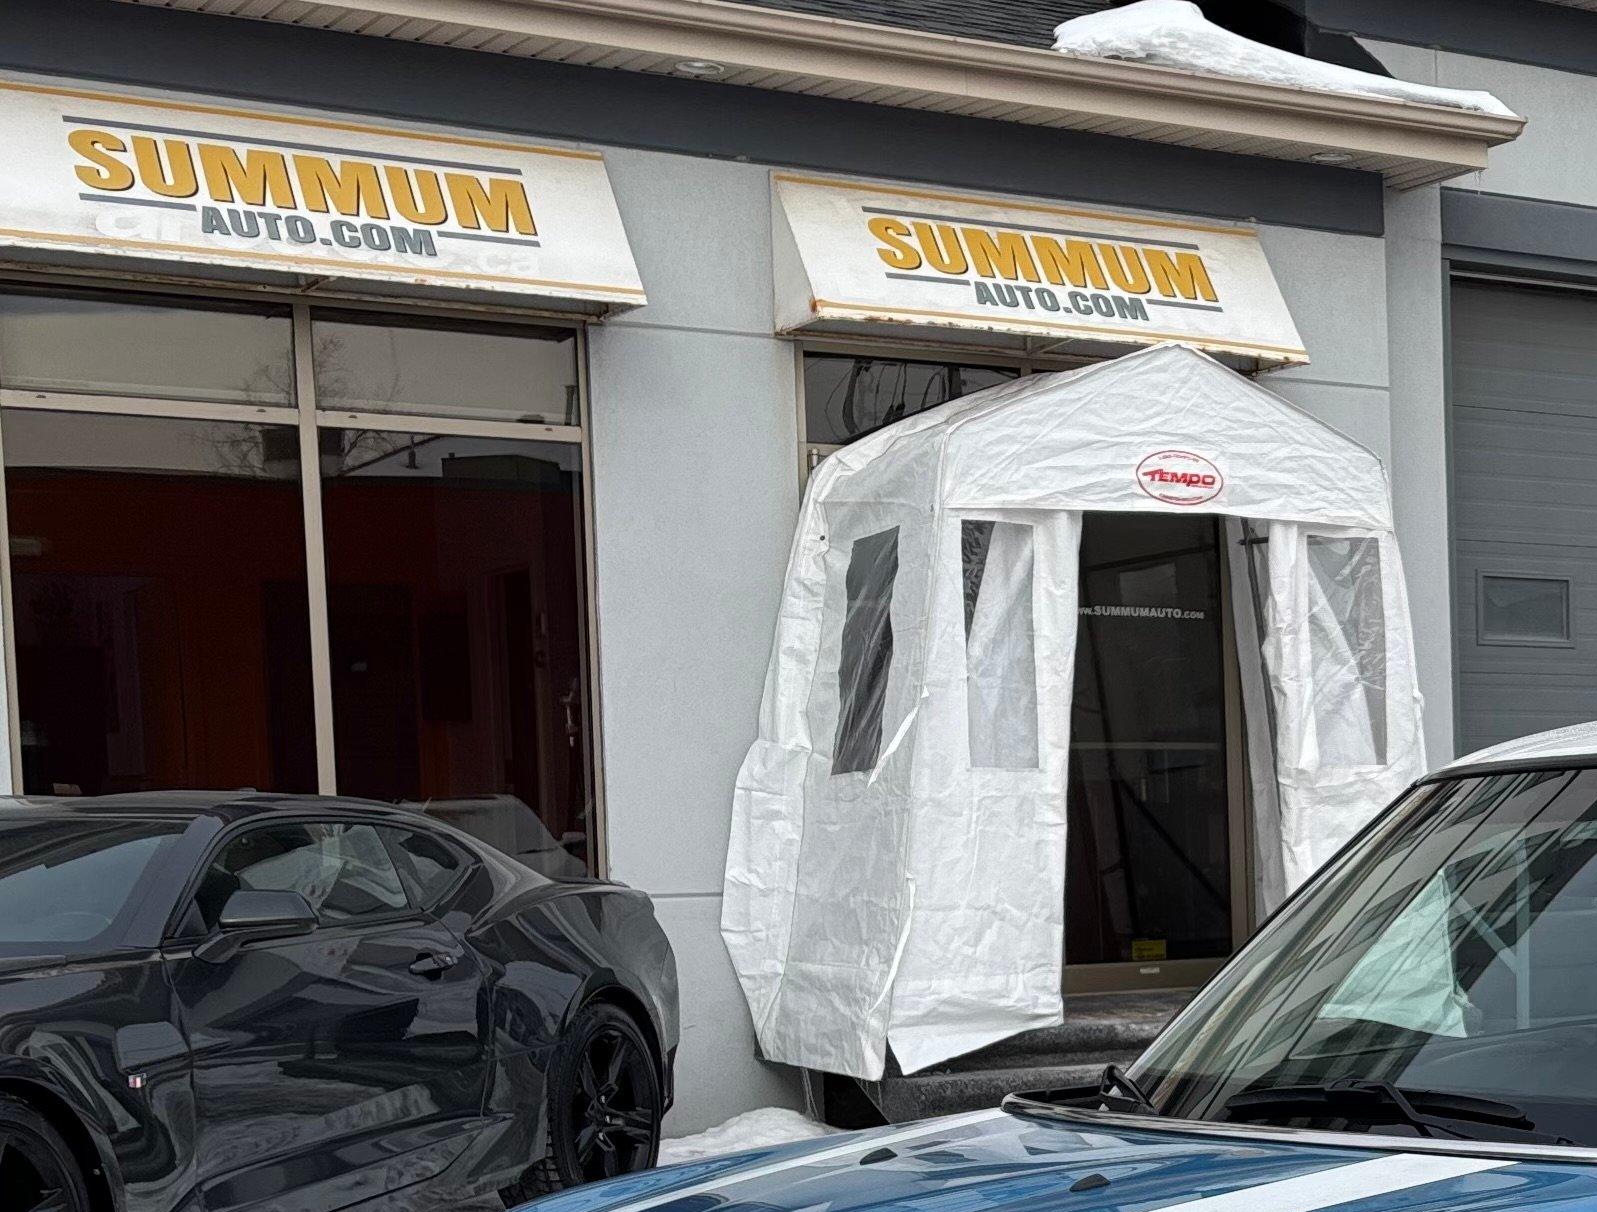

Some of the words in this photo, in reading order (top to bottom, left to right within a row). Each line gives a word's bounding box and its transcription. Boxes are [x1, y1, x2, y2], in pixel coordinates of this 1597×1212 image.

[67, 129, 539, 236] SUMMUM
[201, 206, 438, 256] AUTO.COM
[867, 216, 1219, 303] SUMMUM
[975, 281, 1150, 322] AUTO.COM
[1142, 468, 1216, 487] TEMPO
